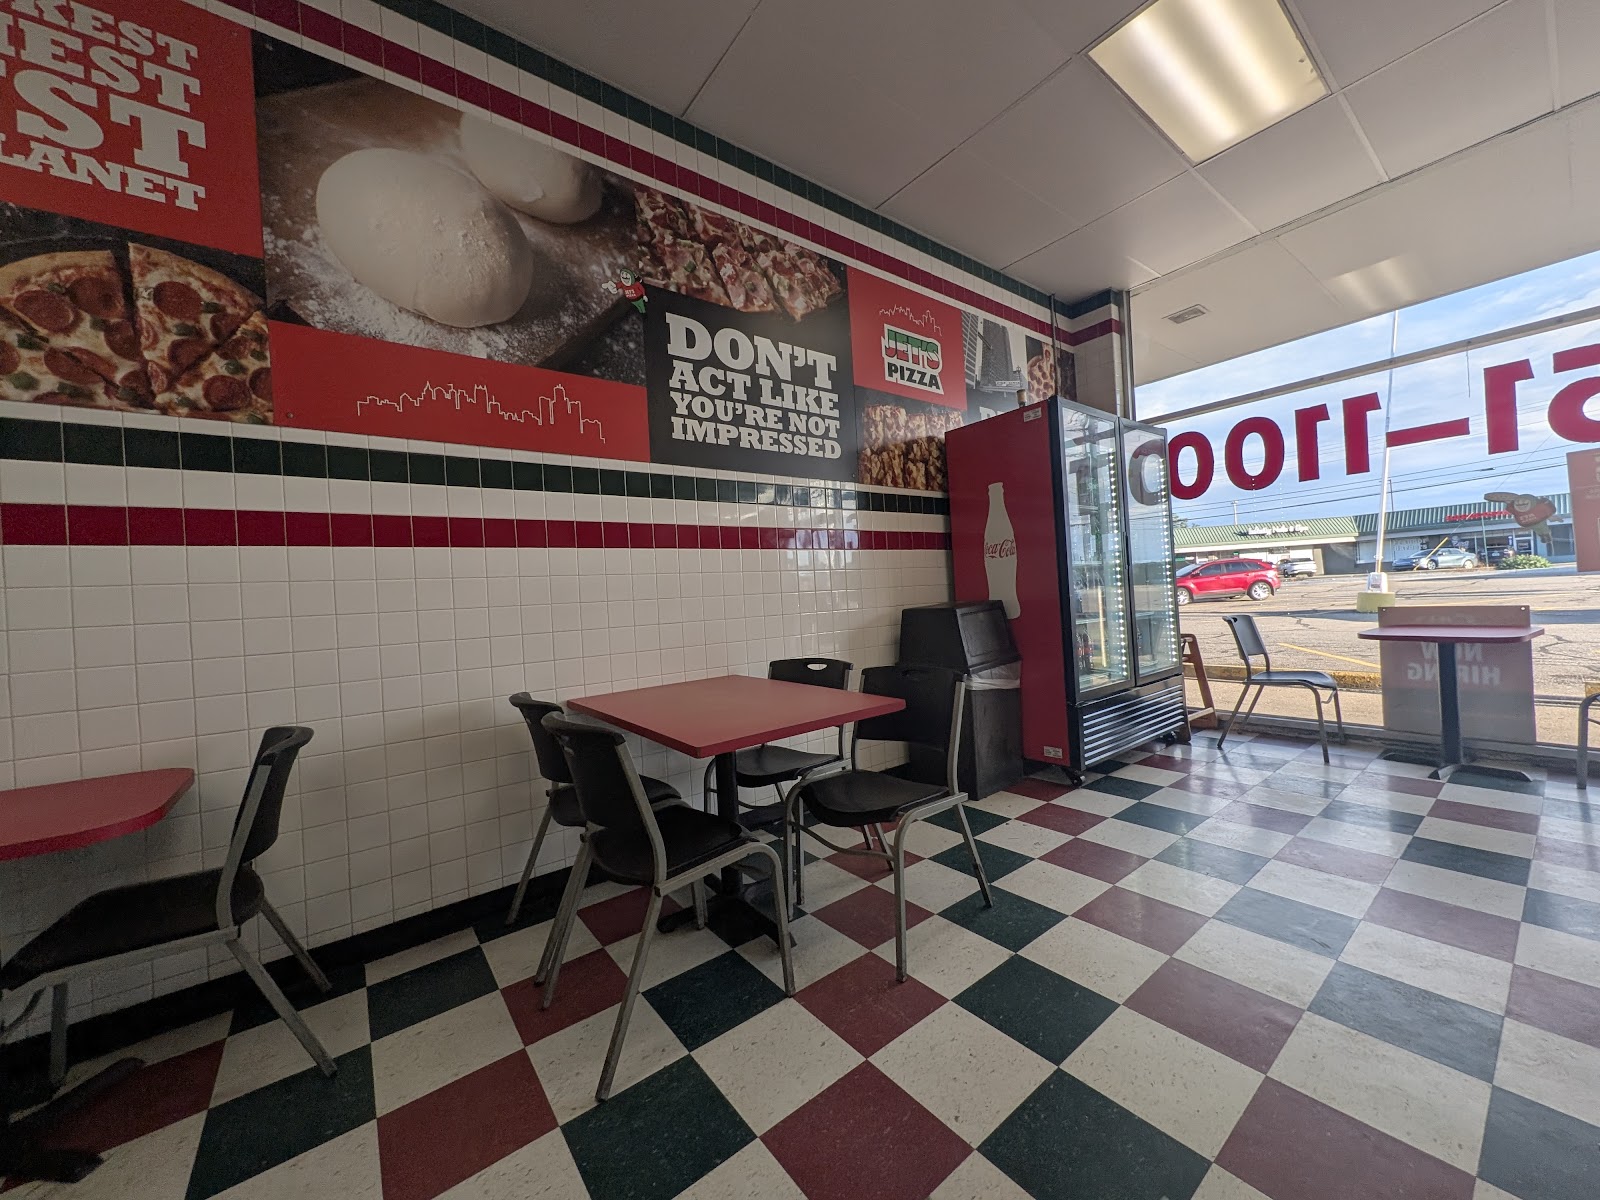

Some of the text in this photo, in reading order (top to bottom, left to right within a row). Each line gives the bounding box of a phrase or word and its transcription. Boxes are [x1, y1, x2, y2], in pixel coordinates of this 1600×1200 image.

[0, 60, 206, 178] ST
[666, 312, 837, 389] DON'T
[887, 362, 941, 390] PIZZA
[669, 359, 839, 418] ACT LIKE
[669, 391, 840, 438] YOU'RE NOT
[671, 416, 842, 459] IMPRESSED
